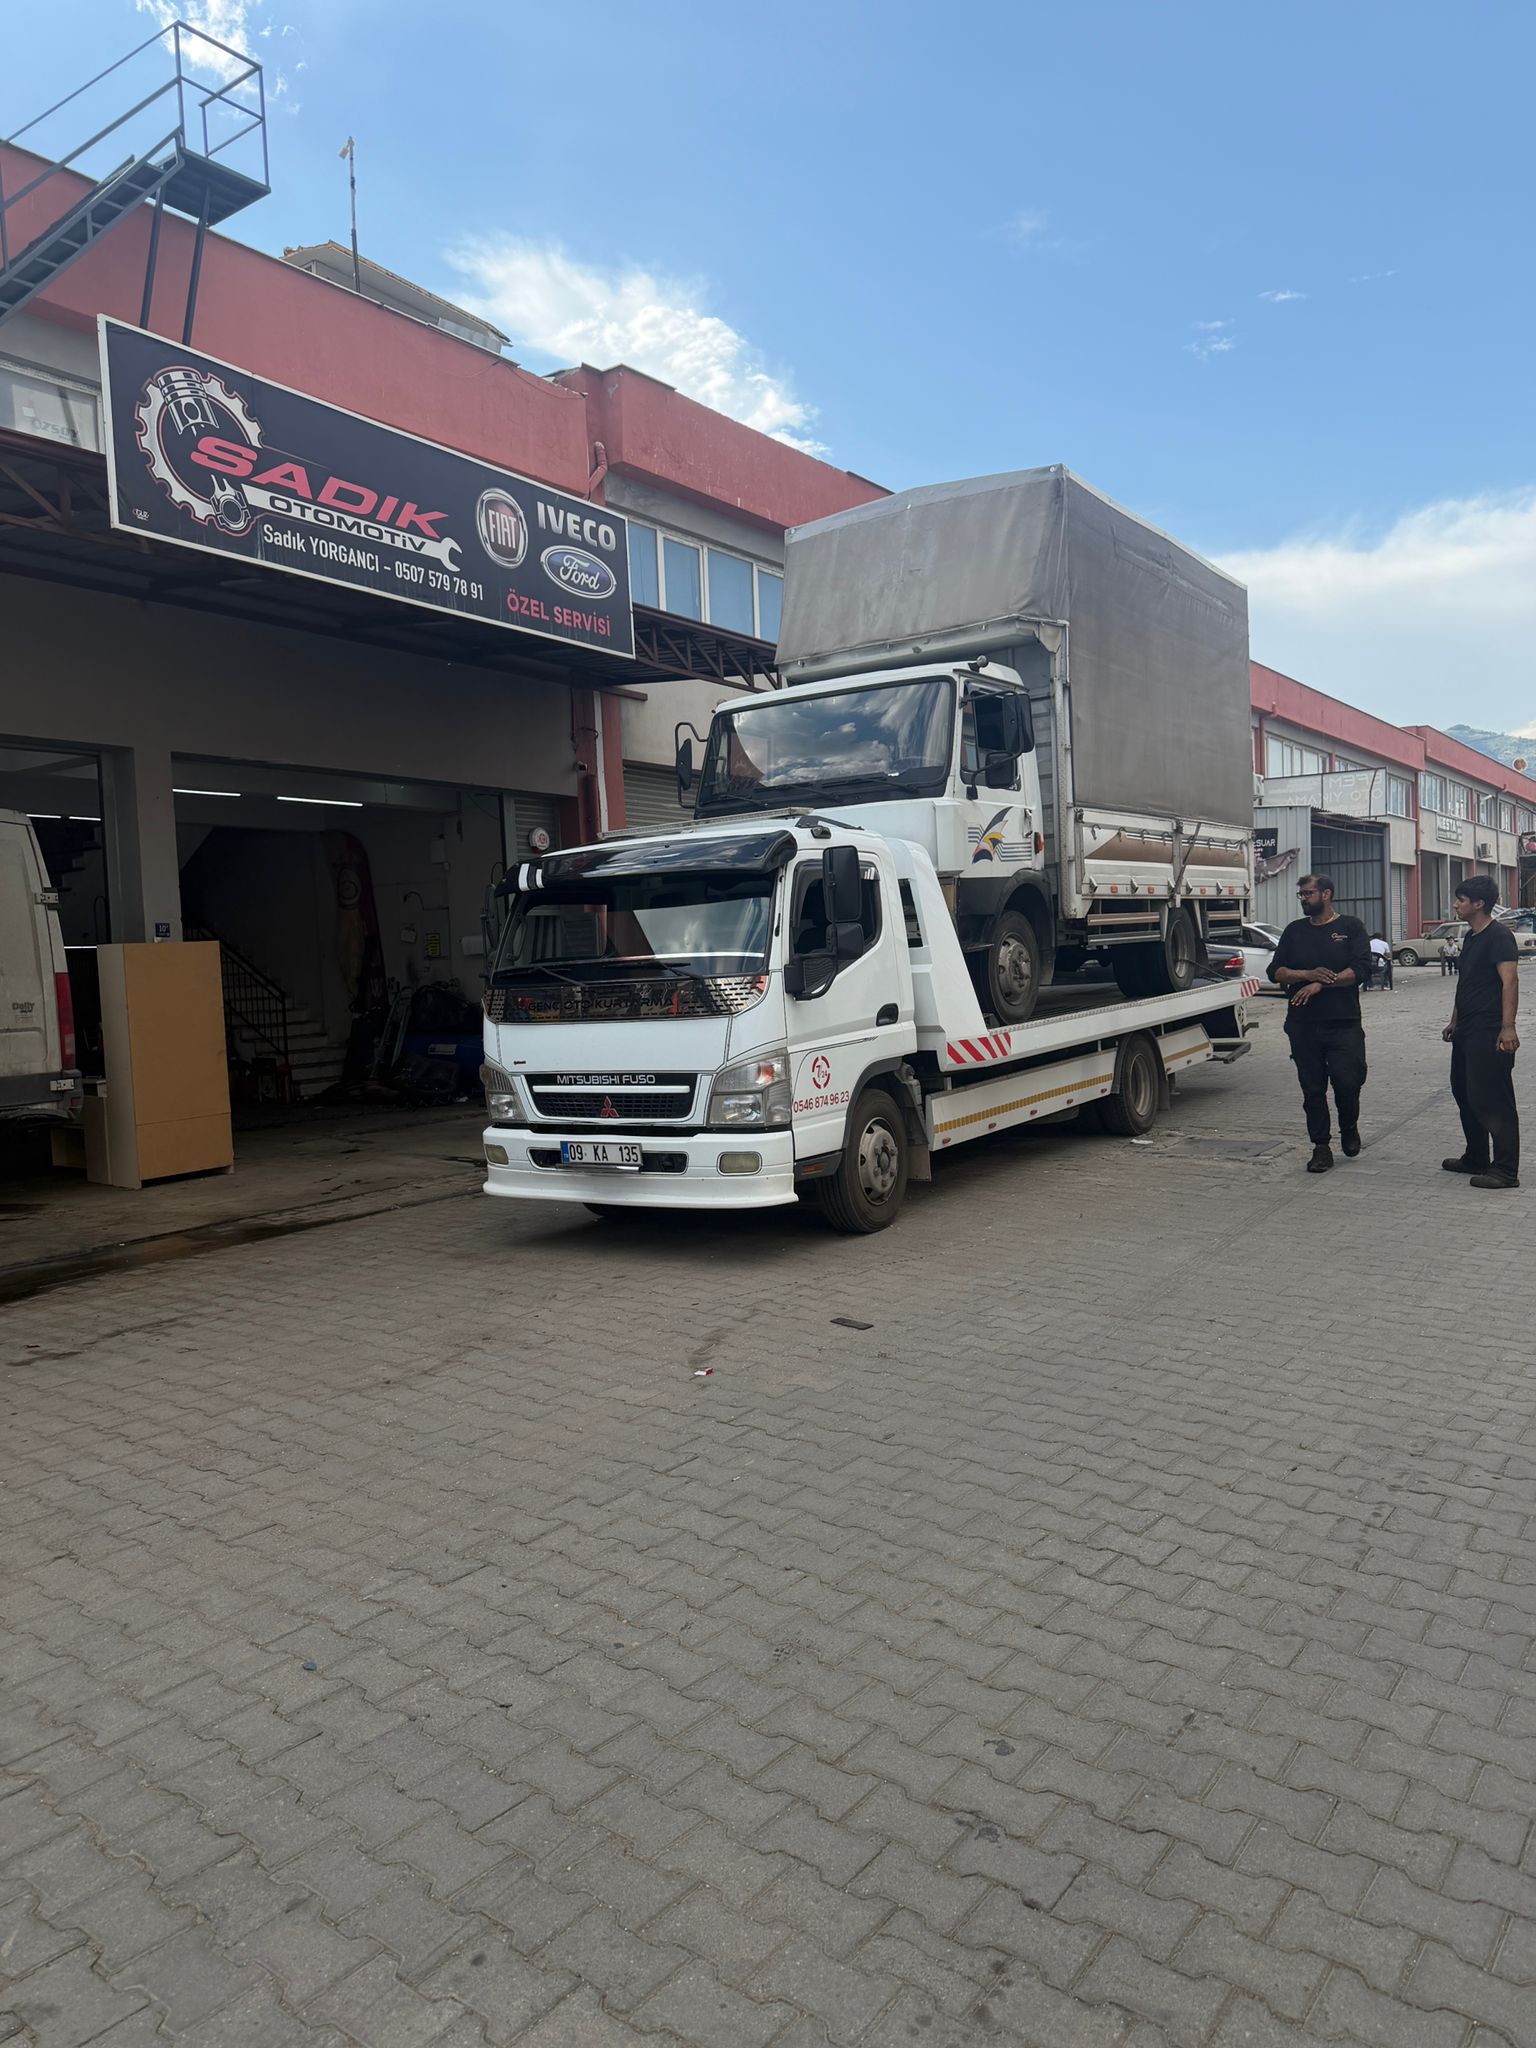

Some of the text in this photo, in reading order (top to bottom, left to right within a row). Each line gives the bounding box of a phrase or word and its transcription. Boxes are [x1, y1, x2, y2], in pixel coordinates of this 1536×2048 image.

[190, 436, 449, 539] SADIK
[488, 509, 517, 549] FIAT
[536, 501, 616, 552] IVECO
[263, 524, 306, 552] Sadık
[309, 536, 380, 573] YORGANCI
[395, 560, 425, 584] 0507
[428, 570, 450, 591] 579
[453, 577, 468, 596] 78
[471, 582, 483, 601] 91
[559, 554, 600, 591] Ford
[507, 588, 611, 637] ÖZEL SERVİSİ
[556, 1074, 656, 1085] MITSUBISHI FUSO
[793, 1090, 850, 1113] 0546 874 96 23
[569, 1144, 639, 1162] 09 KA 135
